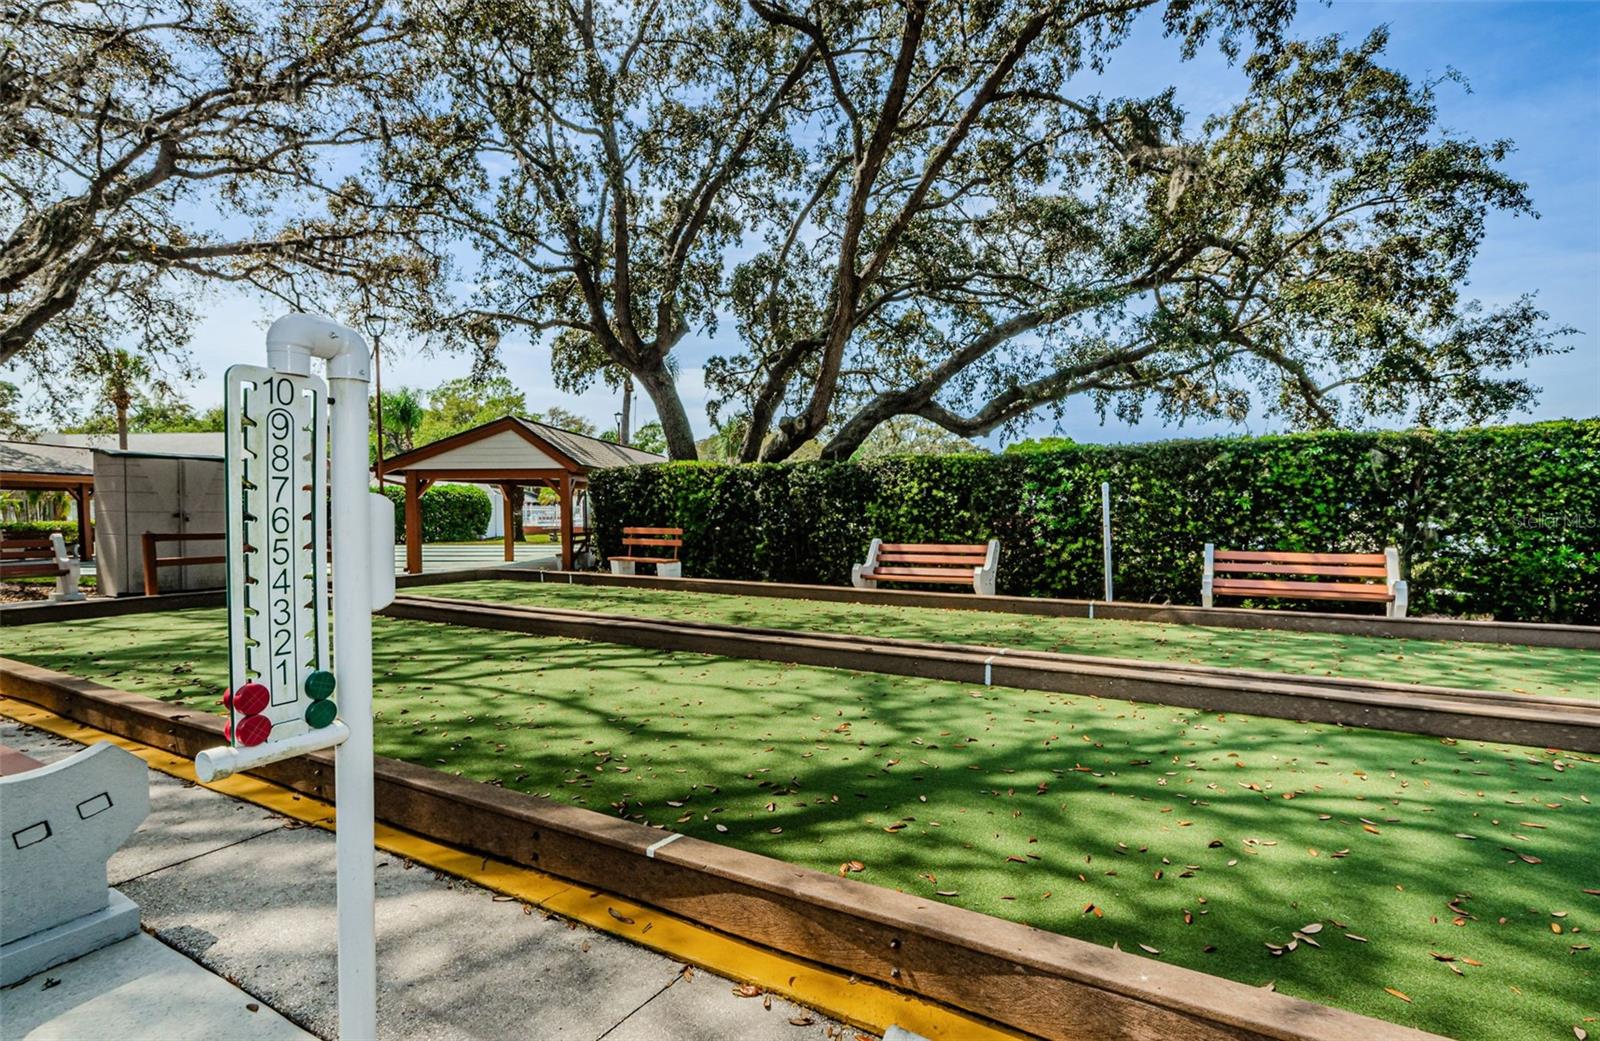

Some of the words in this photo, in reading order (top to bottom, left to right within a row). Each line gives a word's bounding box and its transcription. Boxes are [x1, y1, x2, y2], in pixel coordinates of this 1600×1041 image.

[263, 377, 294, 406] 10
[271, 413, 289, 440] 9
[271, 444, 289, 472] 8
[271, 476, 289, 503] 7
[271, 507, 289, 533] 6
[272, 538, 290, 565] 5
[272, 568, 290, 594] 4
[273, 598, 291, 626] 3
[274, 629, 291, 656] 2
[276, 659, 287, 685] 1
